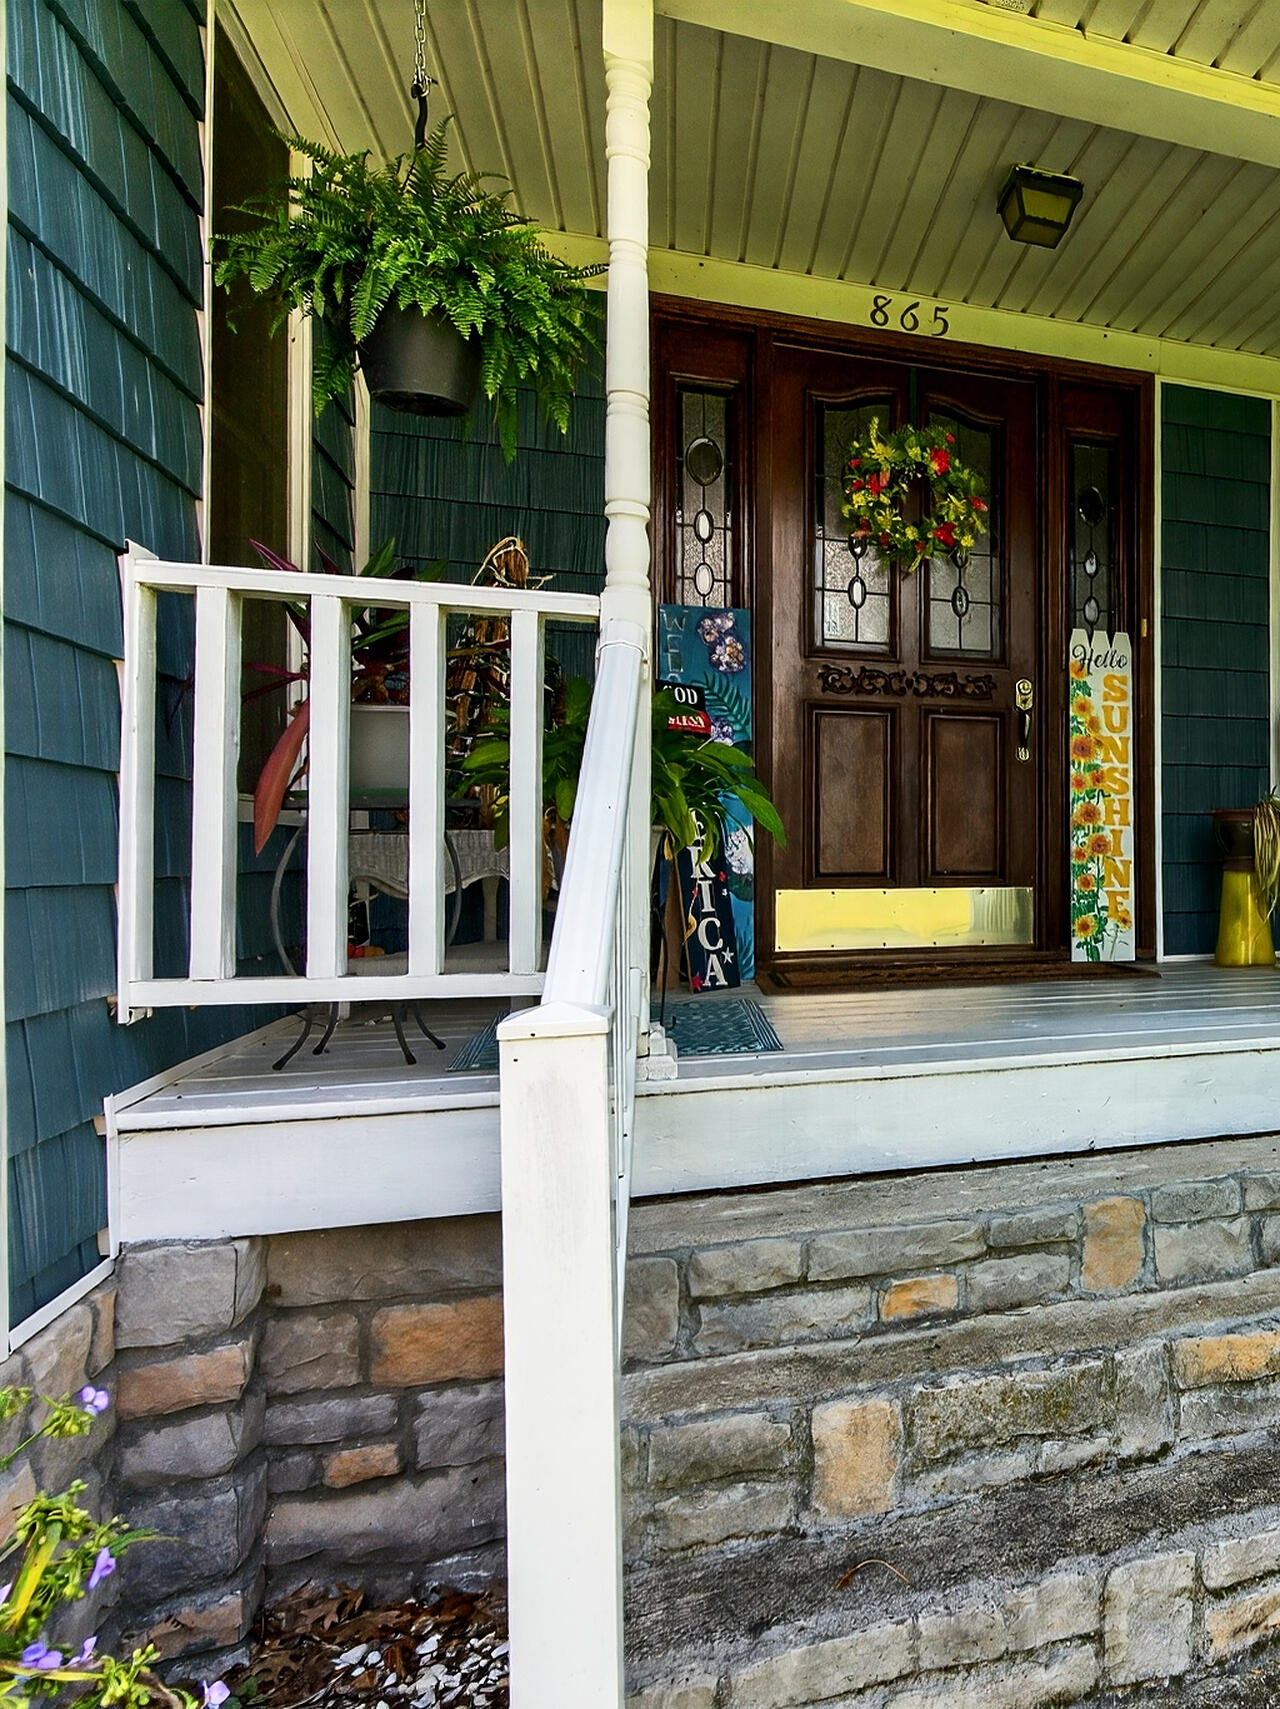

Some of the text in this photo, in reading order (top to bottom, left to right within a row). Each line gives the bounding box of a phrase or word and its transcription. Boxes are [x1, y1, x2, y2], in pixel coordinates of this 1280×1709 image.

[869, 294, 950, 337] 865
[1072, 645, 1128, 676] Hello
[662, 685, 698, 705] OD
[1102, 673, 1132, 921] SUNSHINE
